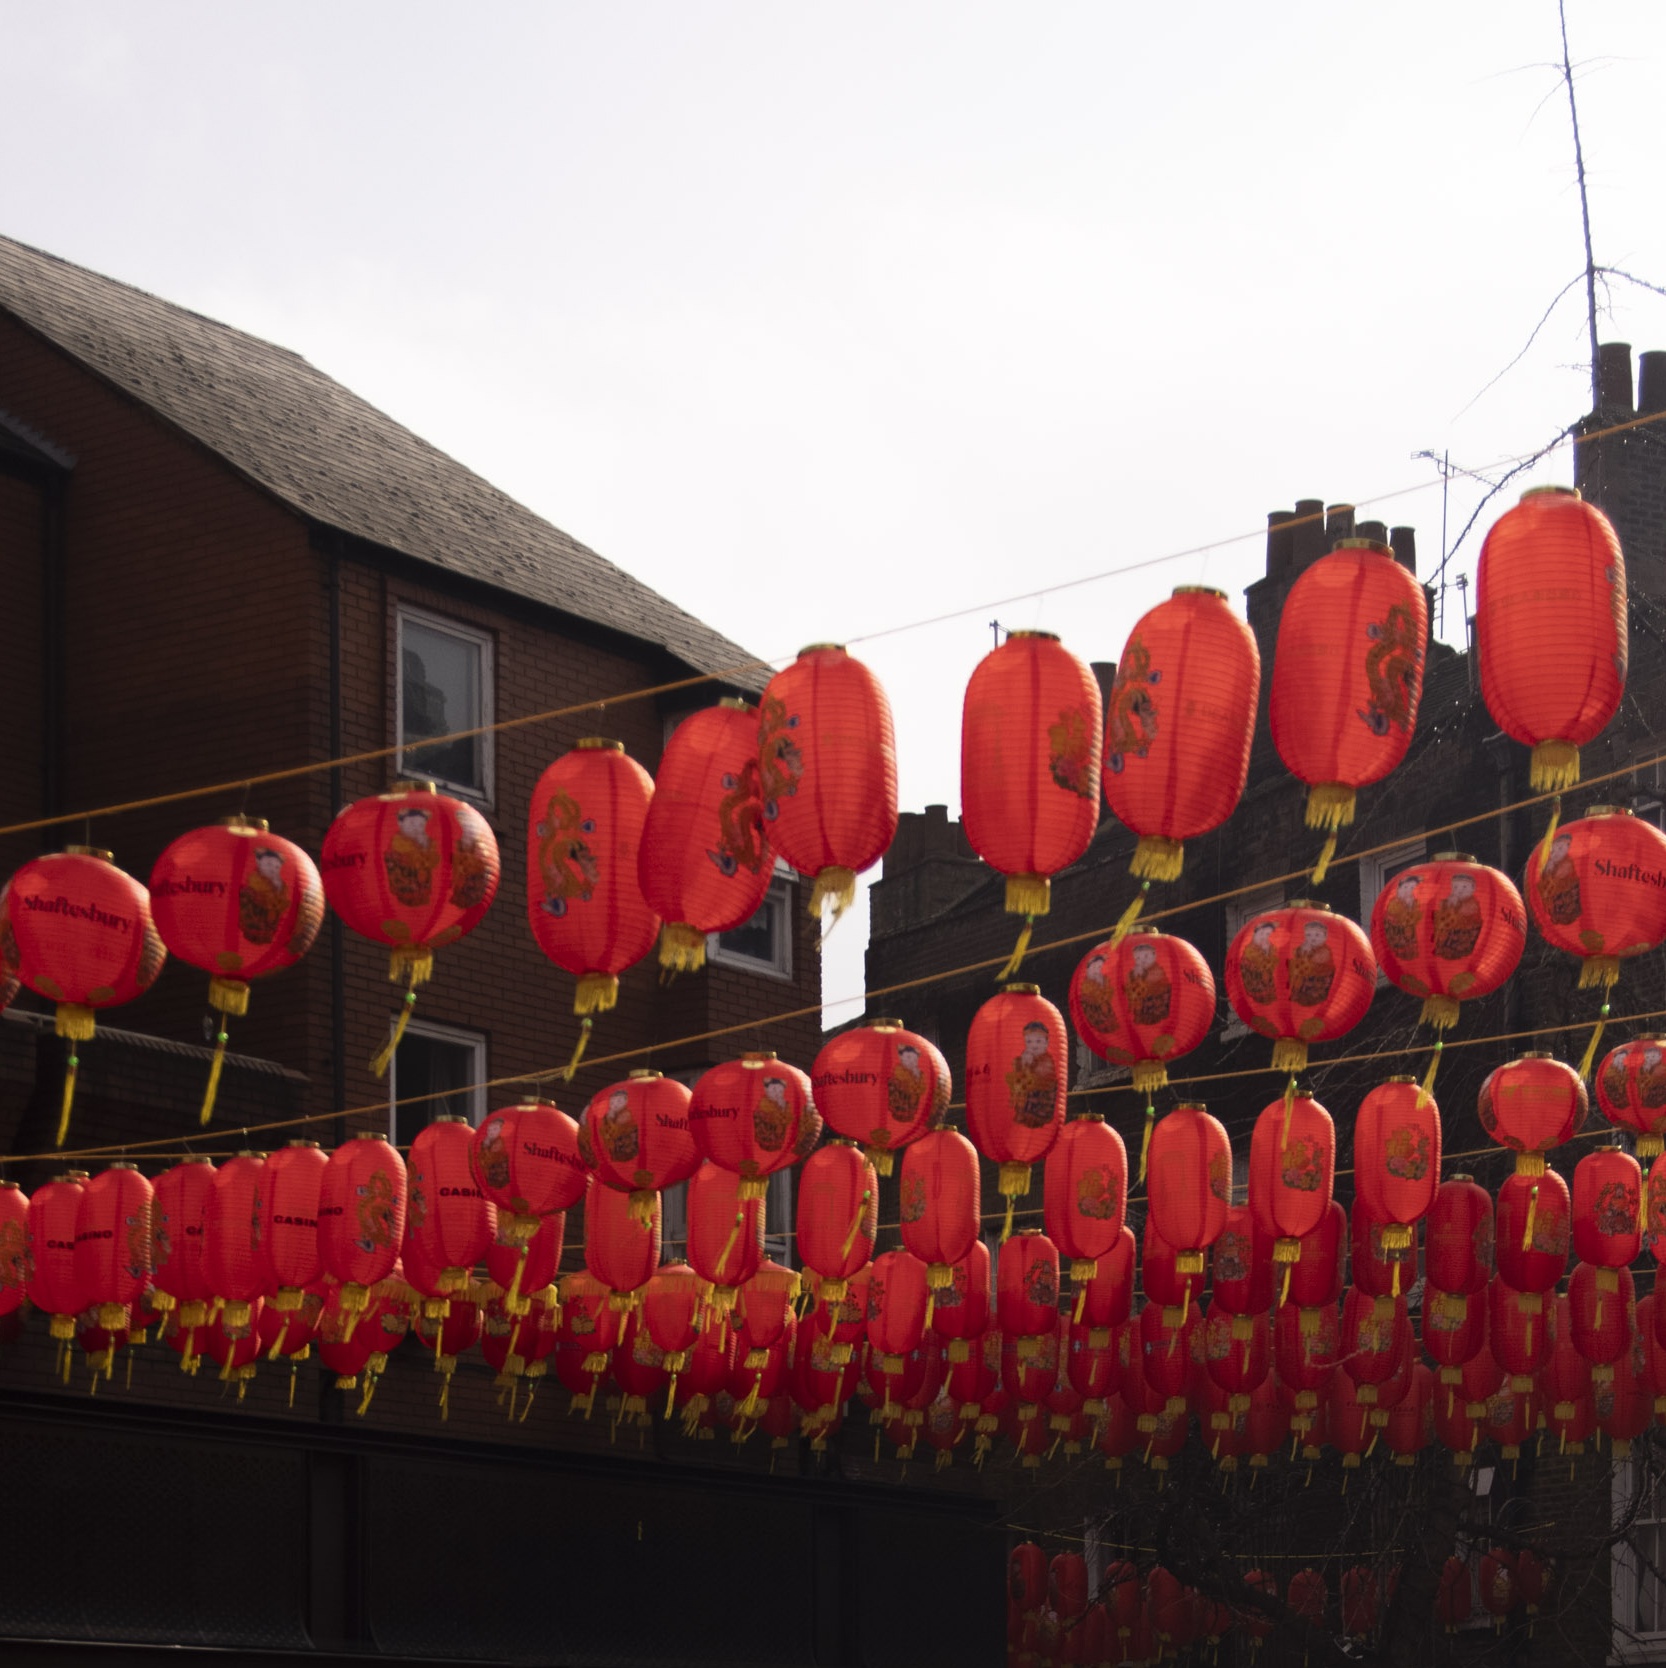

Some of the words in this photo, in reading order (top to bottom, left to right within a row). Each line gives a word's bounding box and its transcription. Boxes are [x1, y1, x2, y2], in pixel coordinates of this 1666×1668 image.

[23, 894, 133, 936] Shaftesbury
[439, 1186, 485, 1198] CASIN
[273, 1214, 318, 1228] CASIN
